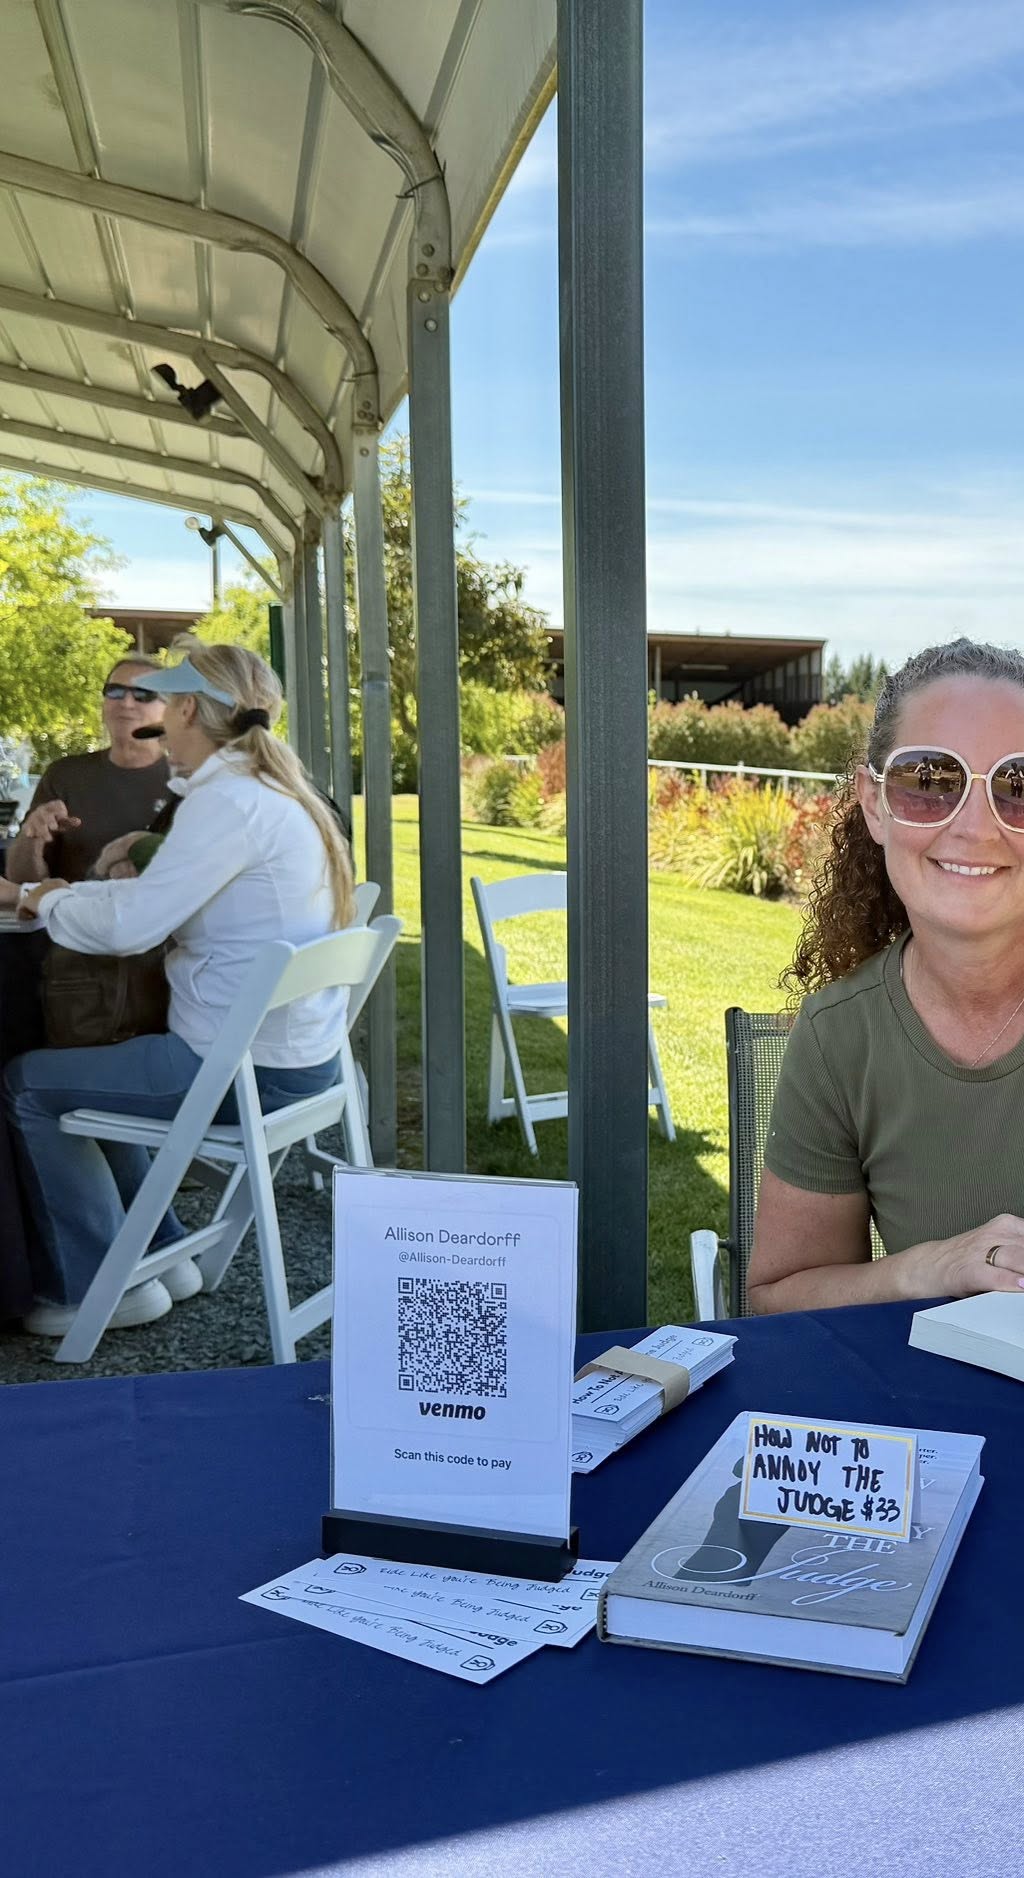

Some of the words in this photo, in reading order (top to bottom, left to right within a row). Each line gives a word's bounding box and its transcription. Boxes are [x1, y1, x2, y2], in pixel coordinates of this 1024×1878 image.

[384, 1226, 434, 1243] Allison
[438, 1229, 521, 1247] Deardorff
[398, 1251, 507, 1267] @Allison-Deardorff
[572, 1391, 594, 1404] How
[598, 1374, 620, 1385] Not
[419, 1401, 486, 1420] venmo
[806, 1431, 841, 1455] NOT
[851, 1437, 869, 1461] TO
[394, 1448, 421, 1461] Scan
[424, 1451, 444, 1463] this
[447, 1454, 474, 1465] code
[477, 1456, 488, 1467] to
[491, 1459, 512, 1470] pay
[753, 1453, 821, 1485] ANNOY
[842, 1465, 884, 1493] THE
[777, 1486, 855, 1522] JUDGE
[860, 1494, 900, 1522] $33
[822, 1533, 898, 1555] THE
[410, 1571, 437, 1580] Like
[486, 1578, 520, 1590] Being
[526, 1583, 571, 1594] Judged
[572, 1569, 612, 1579] udg
[641, 1580, 688, 1593] Allison
[691, 1586, 758, 1601] Deardorff
[486, 1608, 532, 1622] Judged
[418, 1639, 462, 1656] Judged
